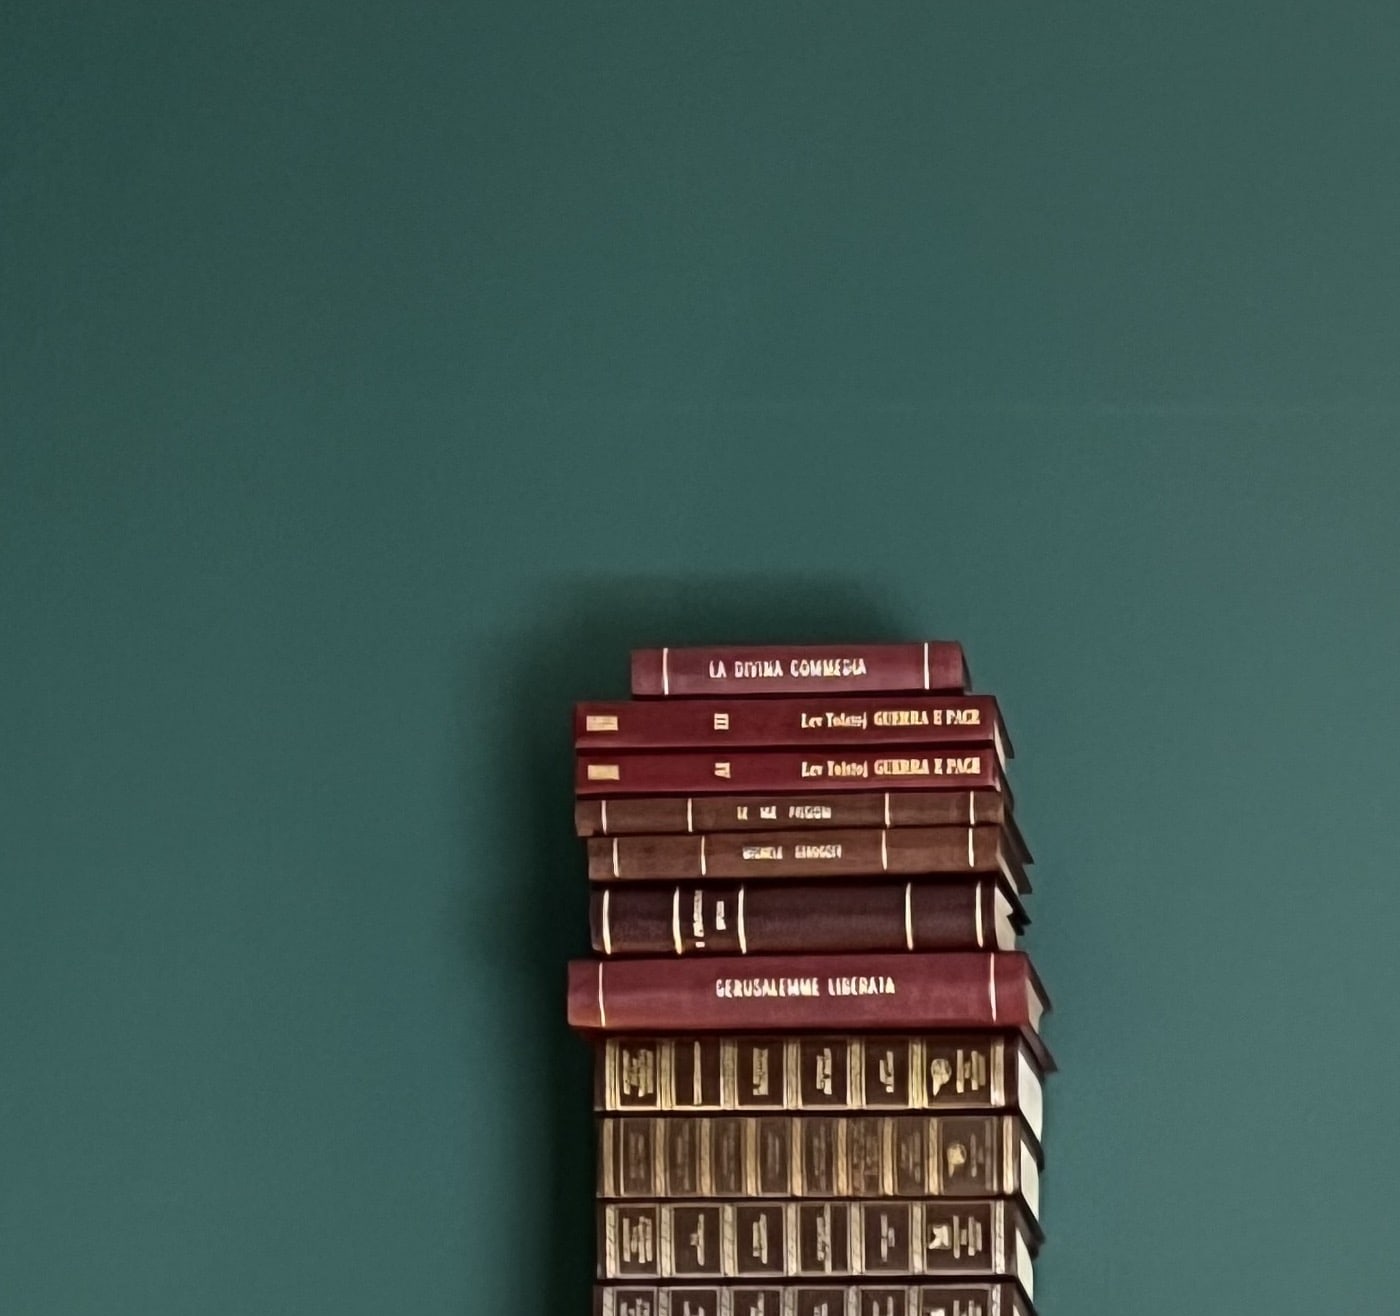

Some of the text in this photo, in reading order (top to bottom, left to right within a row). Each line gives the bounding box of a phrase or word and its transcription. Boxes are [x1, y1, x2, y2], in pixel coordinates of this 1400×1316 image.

[709, 658, 867, 678] LA DIVINA COMMEDIA
[801, 712, 823, 729] Lev
[873, 709, 929, 726] GUERRA
[933, 709, 942, 726] E
[946, 708, 981, 725] PACE
[801, 761, 823, 778] Lev
[873, 758, 930, 775] GUERRA
[946, 756, 981, 774] PACE
[715, 976, 896, 998] GERUSALEMME LIBERATA
